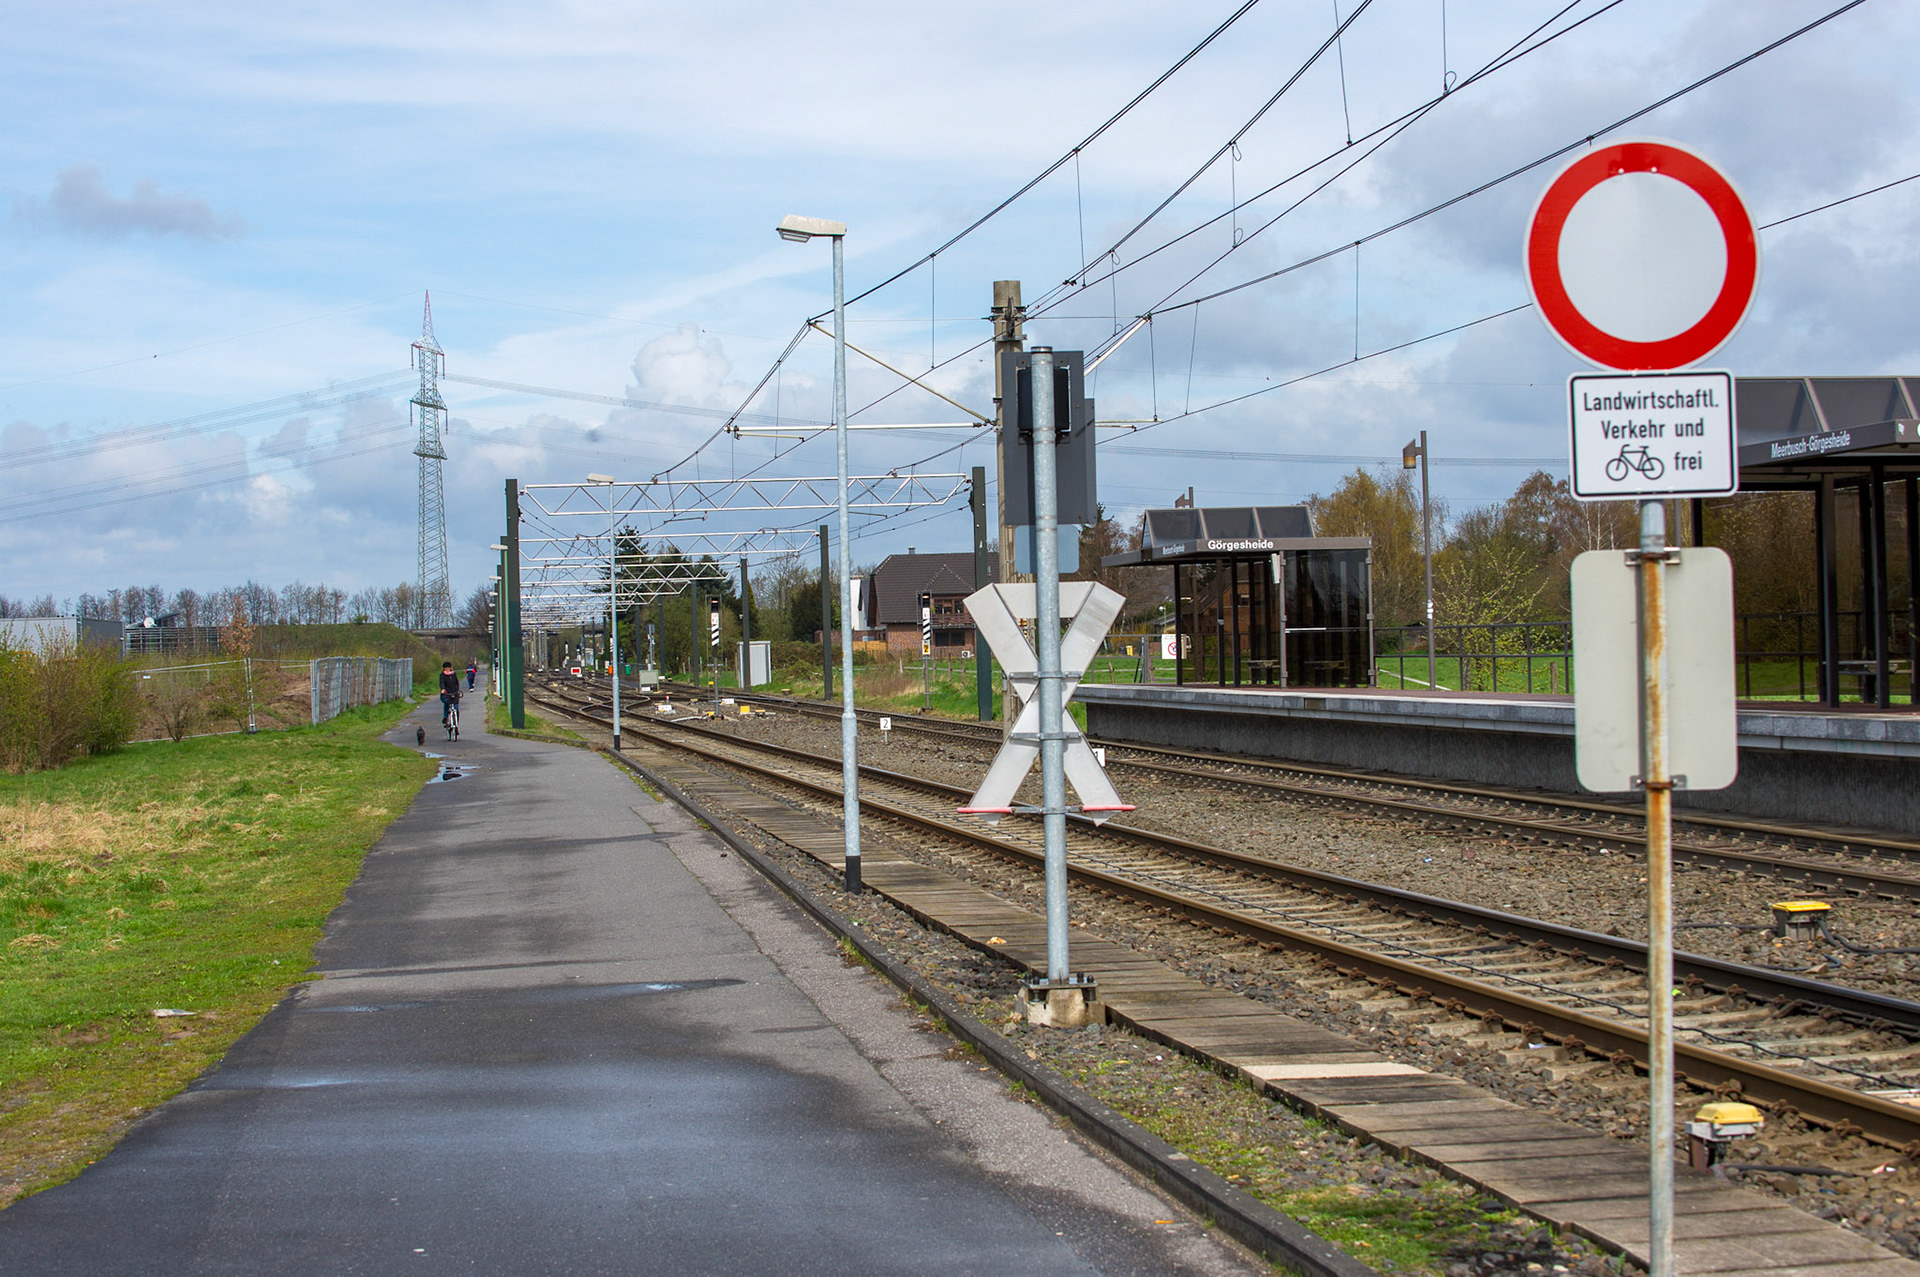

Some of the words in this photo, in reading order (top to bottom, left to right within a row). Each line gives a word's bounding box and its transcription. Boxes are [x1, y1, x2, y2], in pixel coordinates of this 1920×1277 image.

[1583, 388, 1719, 411] Landwirtschaftl.
[1601, 419, 1665, 439] Verkehr
[1675, 417, 1704, 437] und
[1674, 451, 1702, 471] frei
[1207, 539, 1274, 551] Görgesheide
[882, 718, 889, 729] 2
